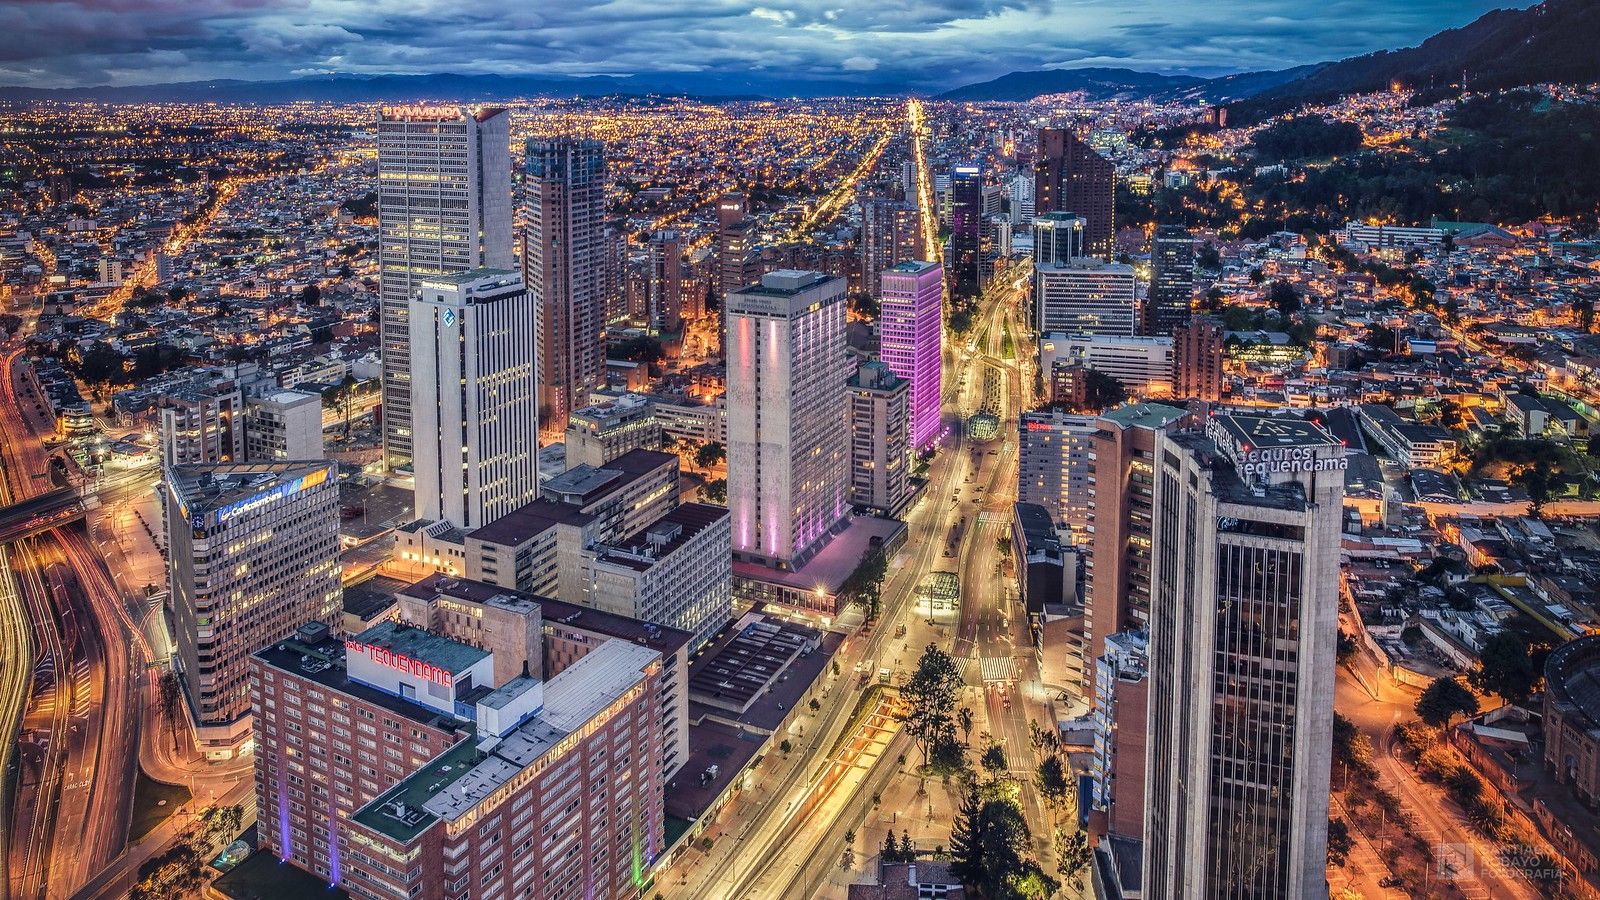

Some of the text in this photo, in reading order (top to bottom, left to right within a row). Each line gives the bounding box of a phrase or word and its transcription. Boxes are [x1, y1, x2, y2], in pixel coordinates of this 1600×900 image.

[393, 105, 462, 117] DAVIVIENDA
[1236, 447, 1311, 463] seguros
[1236, 457, 1349, 475] tequendama
[231, 492, 282, 515] Corficolombiana
[367, 644, 452, 688] TEQUENDAMA
